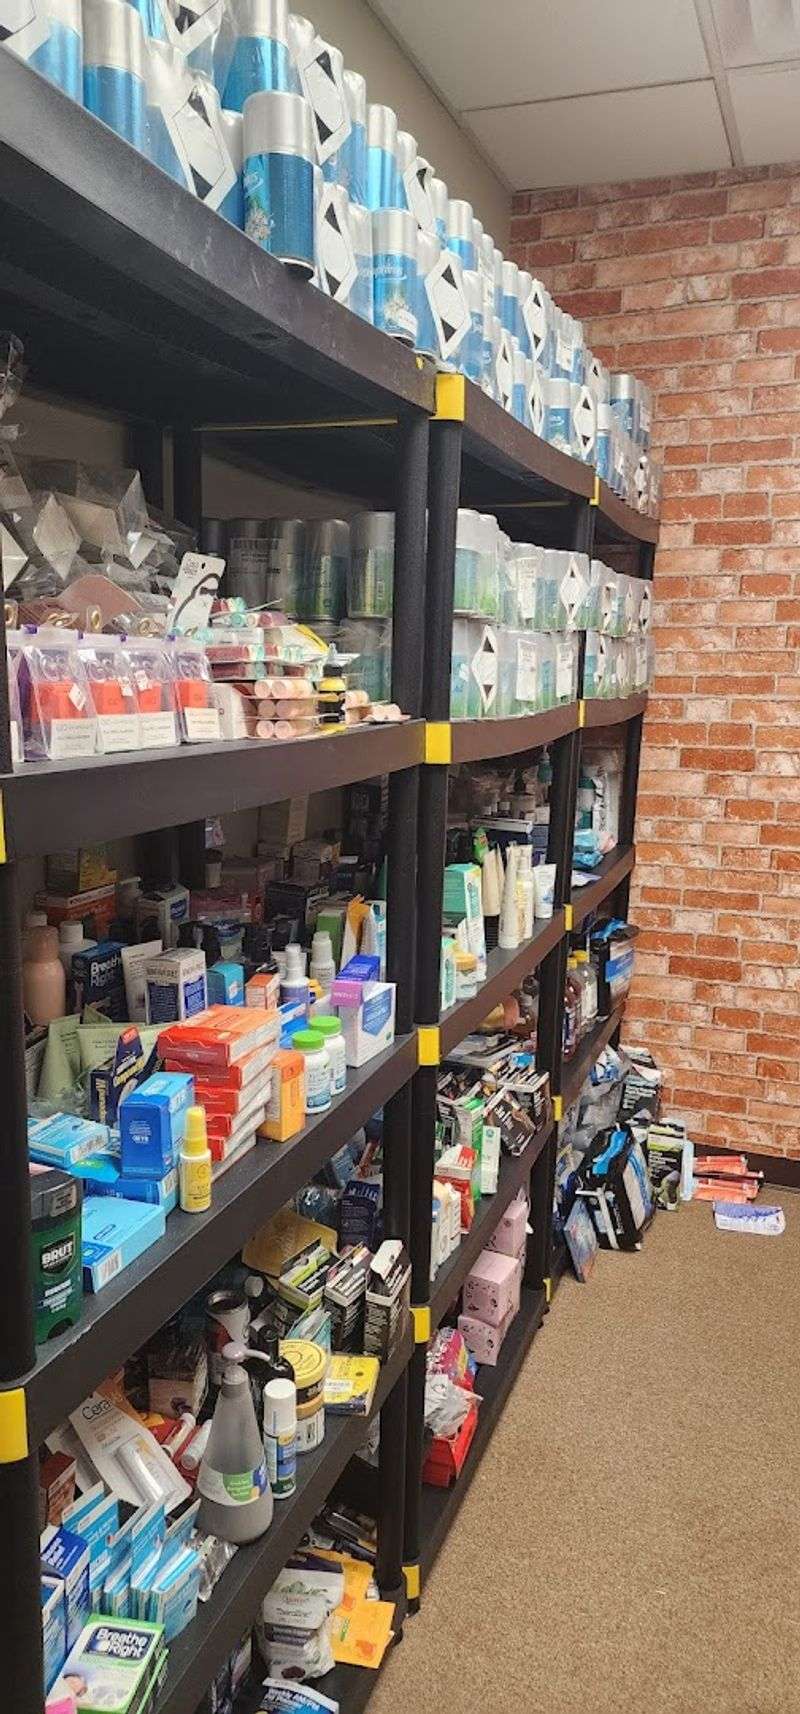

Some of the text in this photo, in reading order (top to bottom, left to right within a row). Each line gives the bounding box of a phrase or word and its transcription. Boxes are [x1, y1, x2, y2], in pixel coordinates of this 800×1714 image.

[42, 1241, 73, 1264] BRUT
[96, 1628, 148, 1647] Breathe
[107, 1642, 143, 1658] Right
